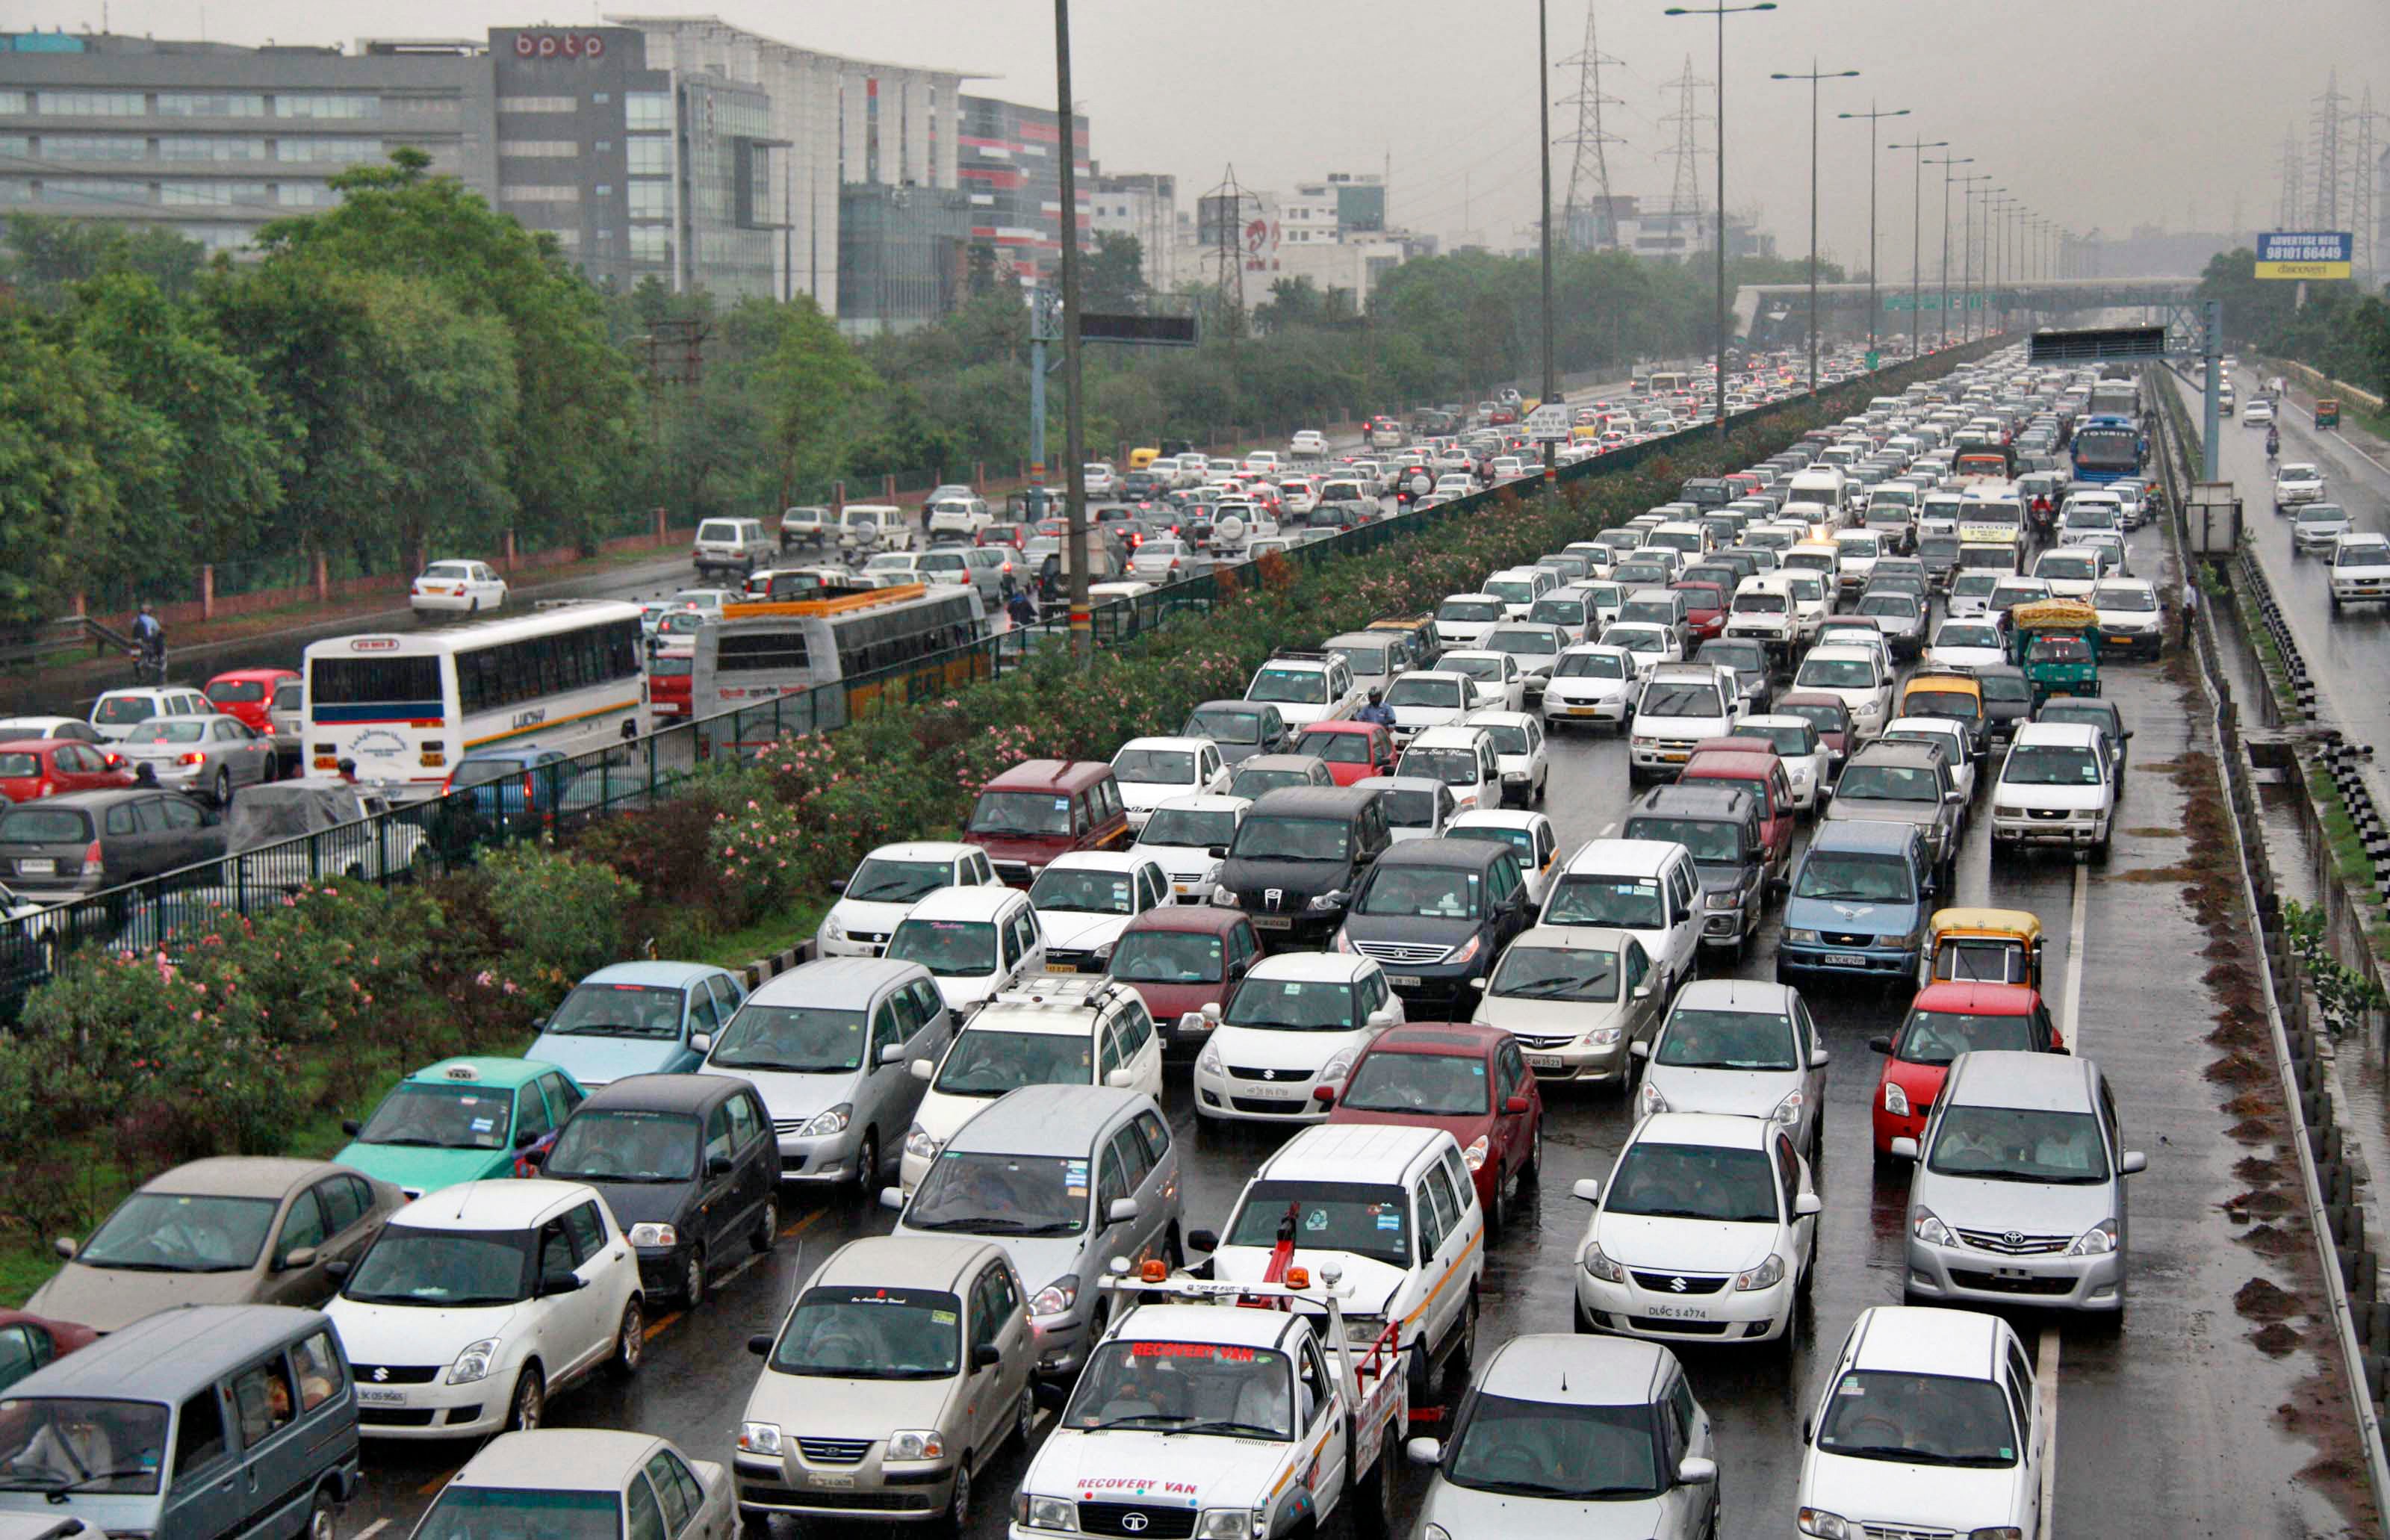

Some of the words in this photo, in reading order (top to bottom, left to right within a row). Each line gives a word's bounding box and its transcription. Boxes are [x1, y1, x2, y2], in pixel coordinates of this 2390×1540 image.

[517, 34, 601, 57] bptp
[2270, 235, 2316, 246] ADVERTISE
[2318, 235, 2341, 246] HERE
[2265, 246, 2301, 260] 98101
[2082, 429, 2135, 438] TOURIST
[1683, 1307, 1707, 1319] 4774
[1132, 1342, 1216, 1359] RECOVERY
[1220, 1347, 1255, 1362] VAN
[1078, 1478, 1157, 1490] RECOVERY
[1164, 1481, 1197, 1494] VAN
